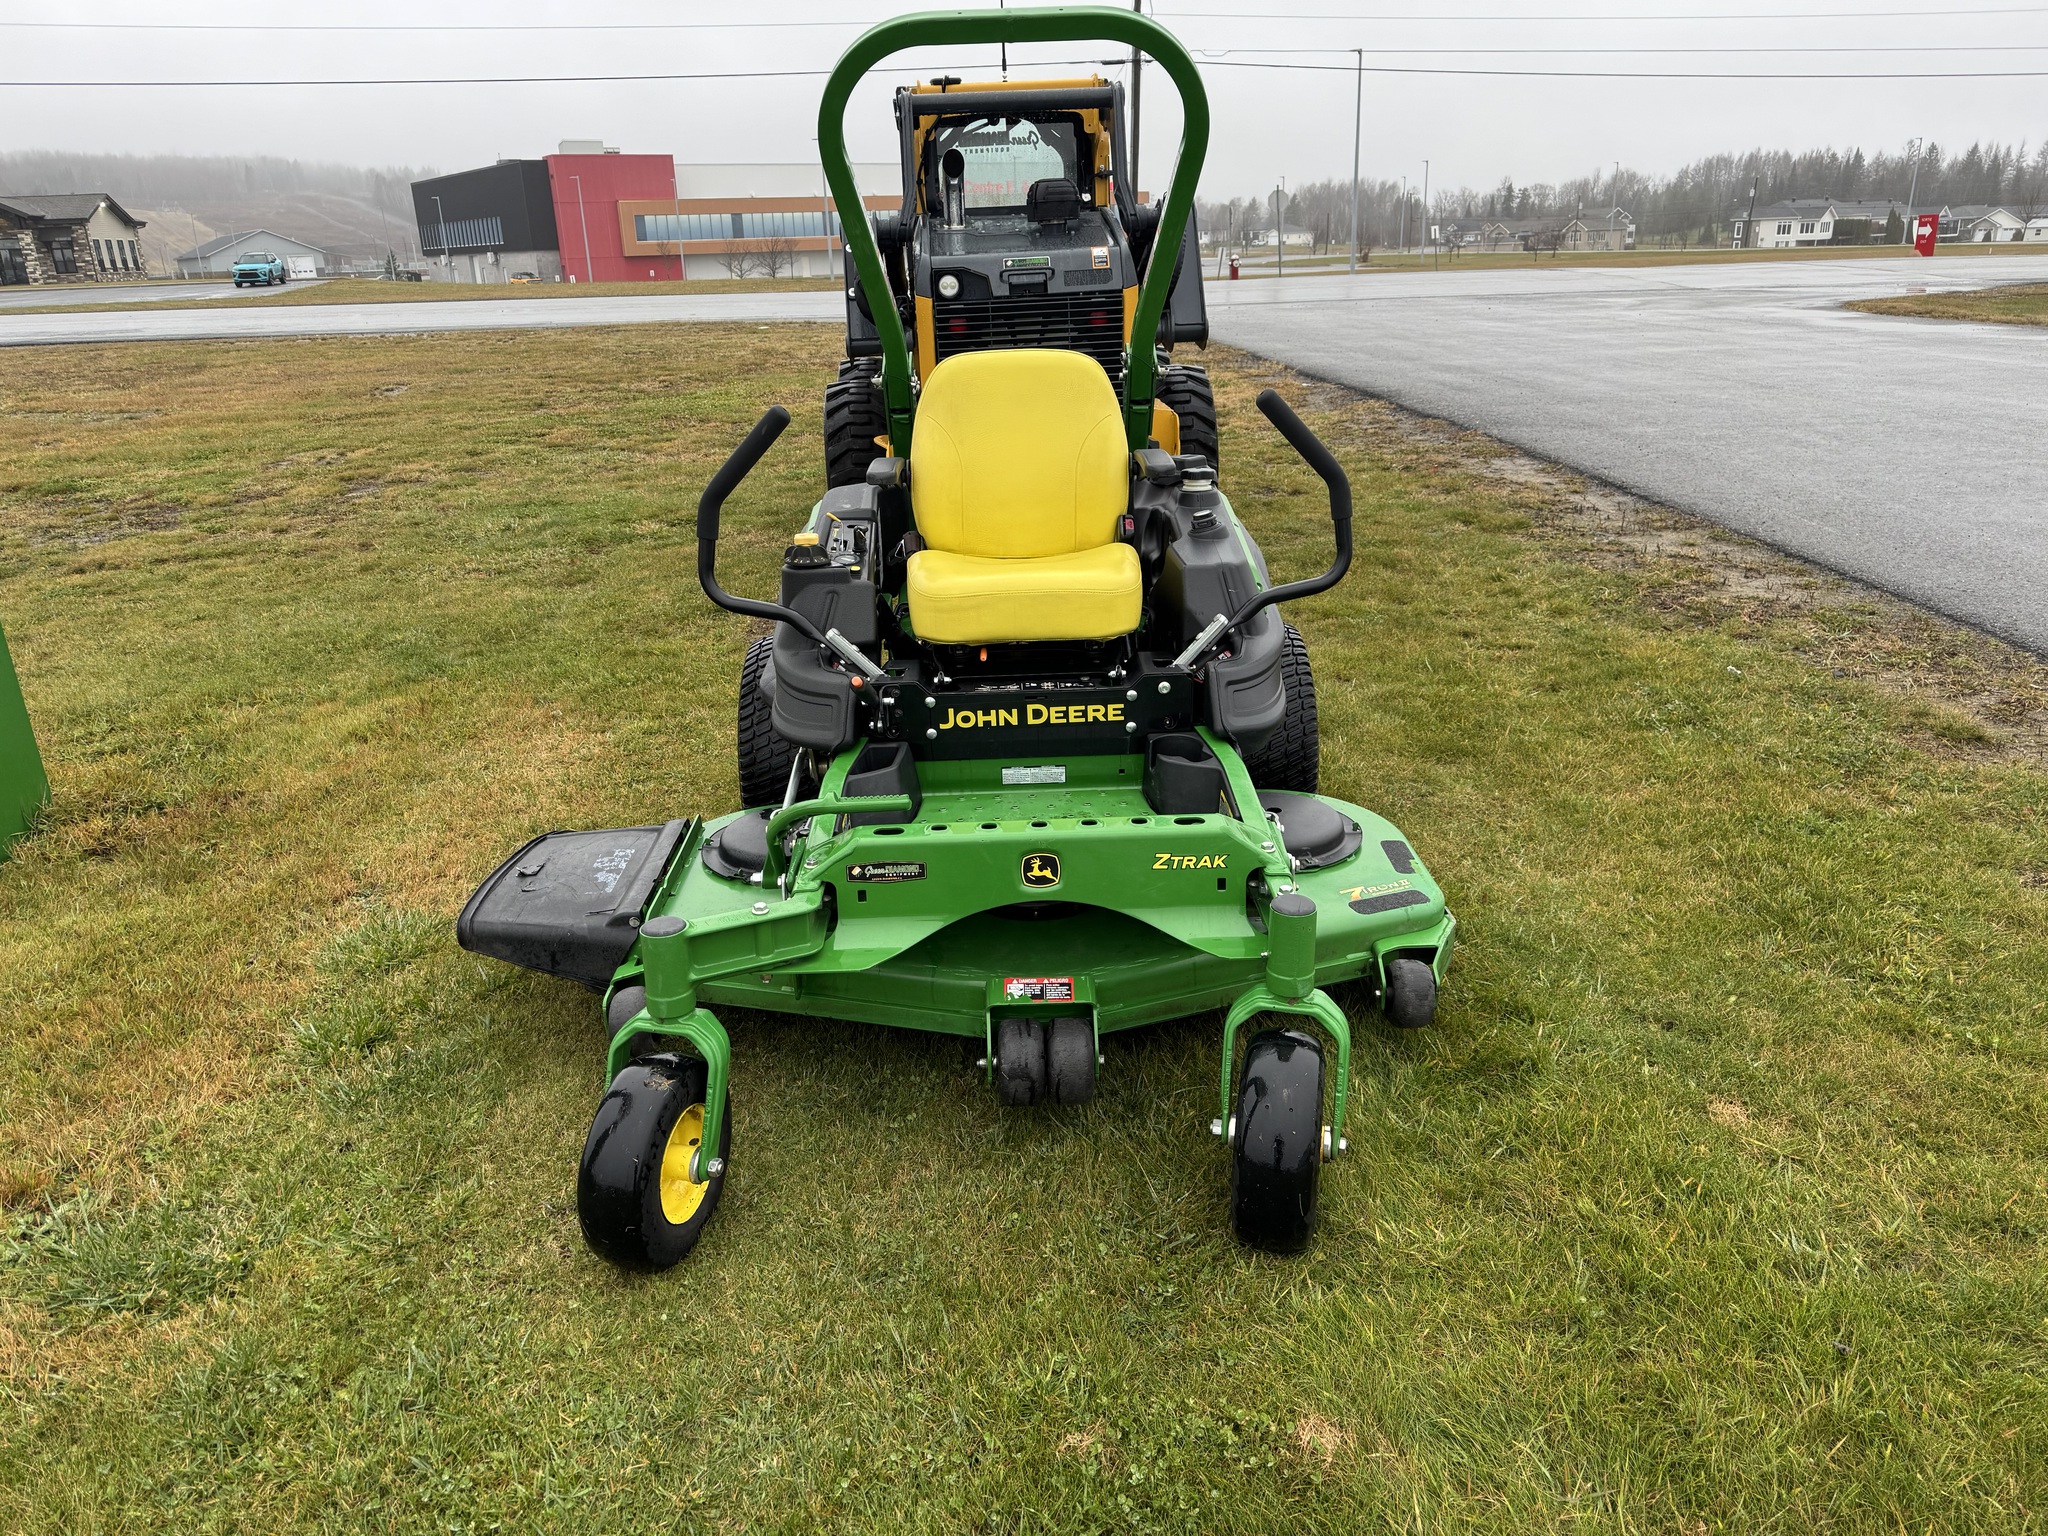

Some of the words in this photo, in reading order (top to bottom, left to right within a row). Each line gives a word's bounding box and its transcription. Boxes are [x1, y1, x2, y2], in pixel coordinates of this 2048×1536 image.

[939, 707, 1019, 730] JOHN
[1026, 703, 1125, 725] DEERE
[1152, 853, 1229, 869] ZTRAK
